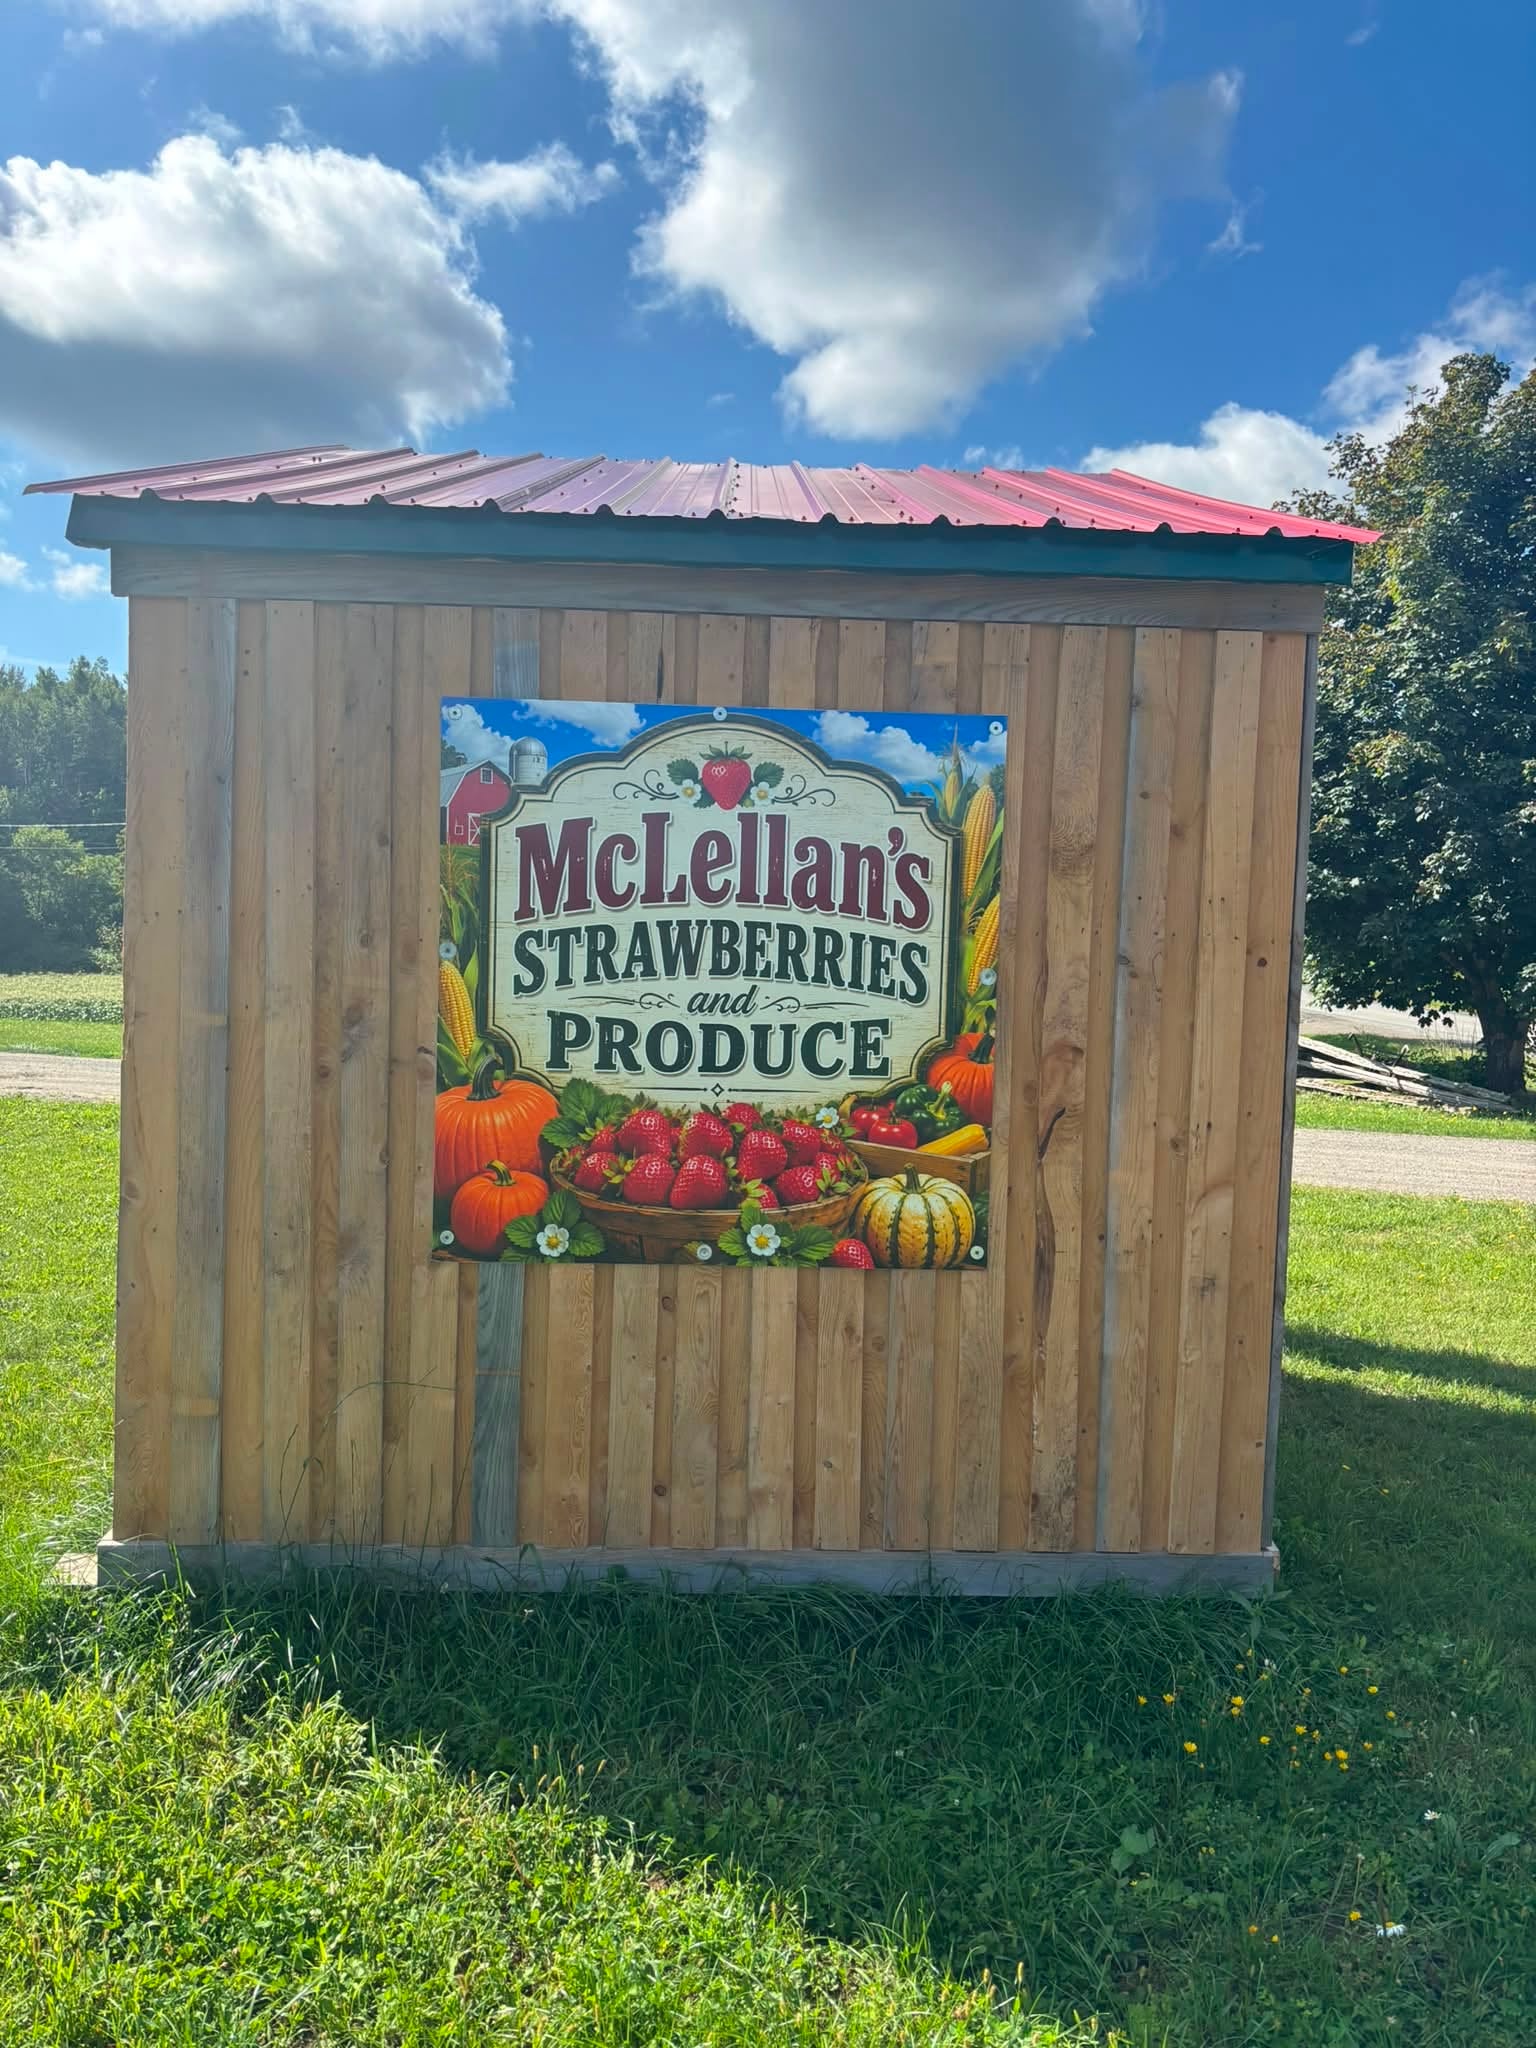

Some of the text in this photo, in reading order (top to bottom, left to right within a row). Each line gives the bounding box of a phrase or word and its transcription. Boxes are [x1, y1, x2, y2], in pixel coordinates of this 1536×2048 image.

[513, 811, 932, 931] McLellan's
[512, 919, 929, 1006] STRAWBERRIES
[687, 984, 758, 1017] and
[545, 1009, 891, 1079] PRODUCE
